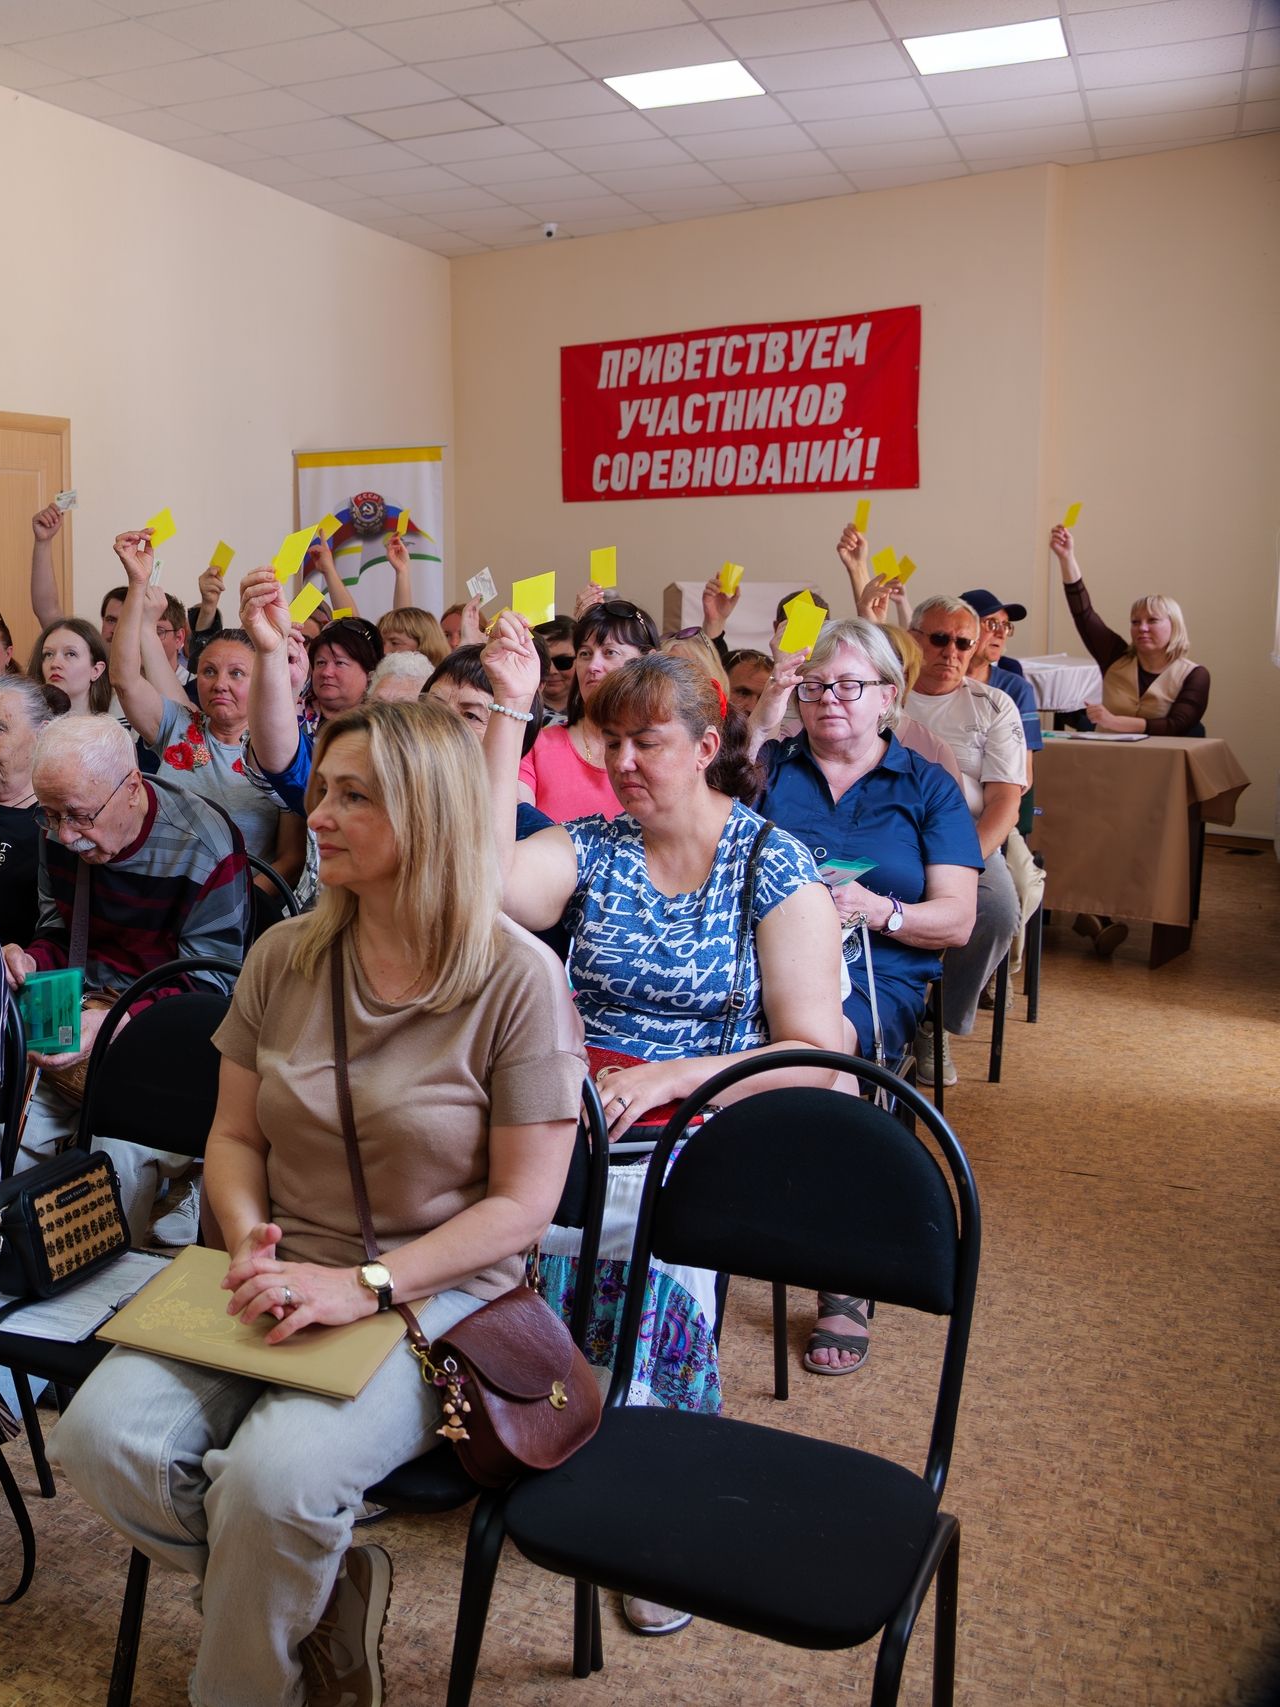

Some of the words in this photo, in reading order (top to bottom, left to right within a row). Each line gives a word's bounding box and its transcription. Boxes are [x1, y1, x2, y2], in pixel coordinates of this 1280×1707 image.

[597, 321, 872, 390] ПРИВЕТСТВУЕМ
[617, 381, 847, 440] УЧАСТНИКОВ
[592, 427, 880, 492] СОРЕВНОВАНИЙ!
